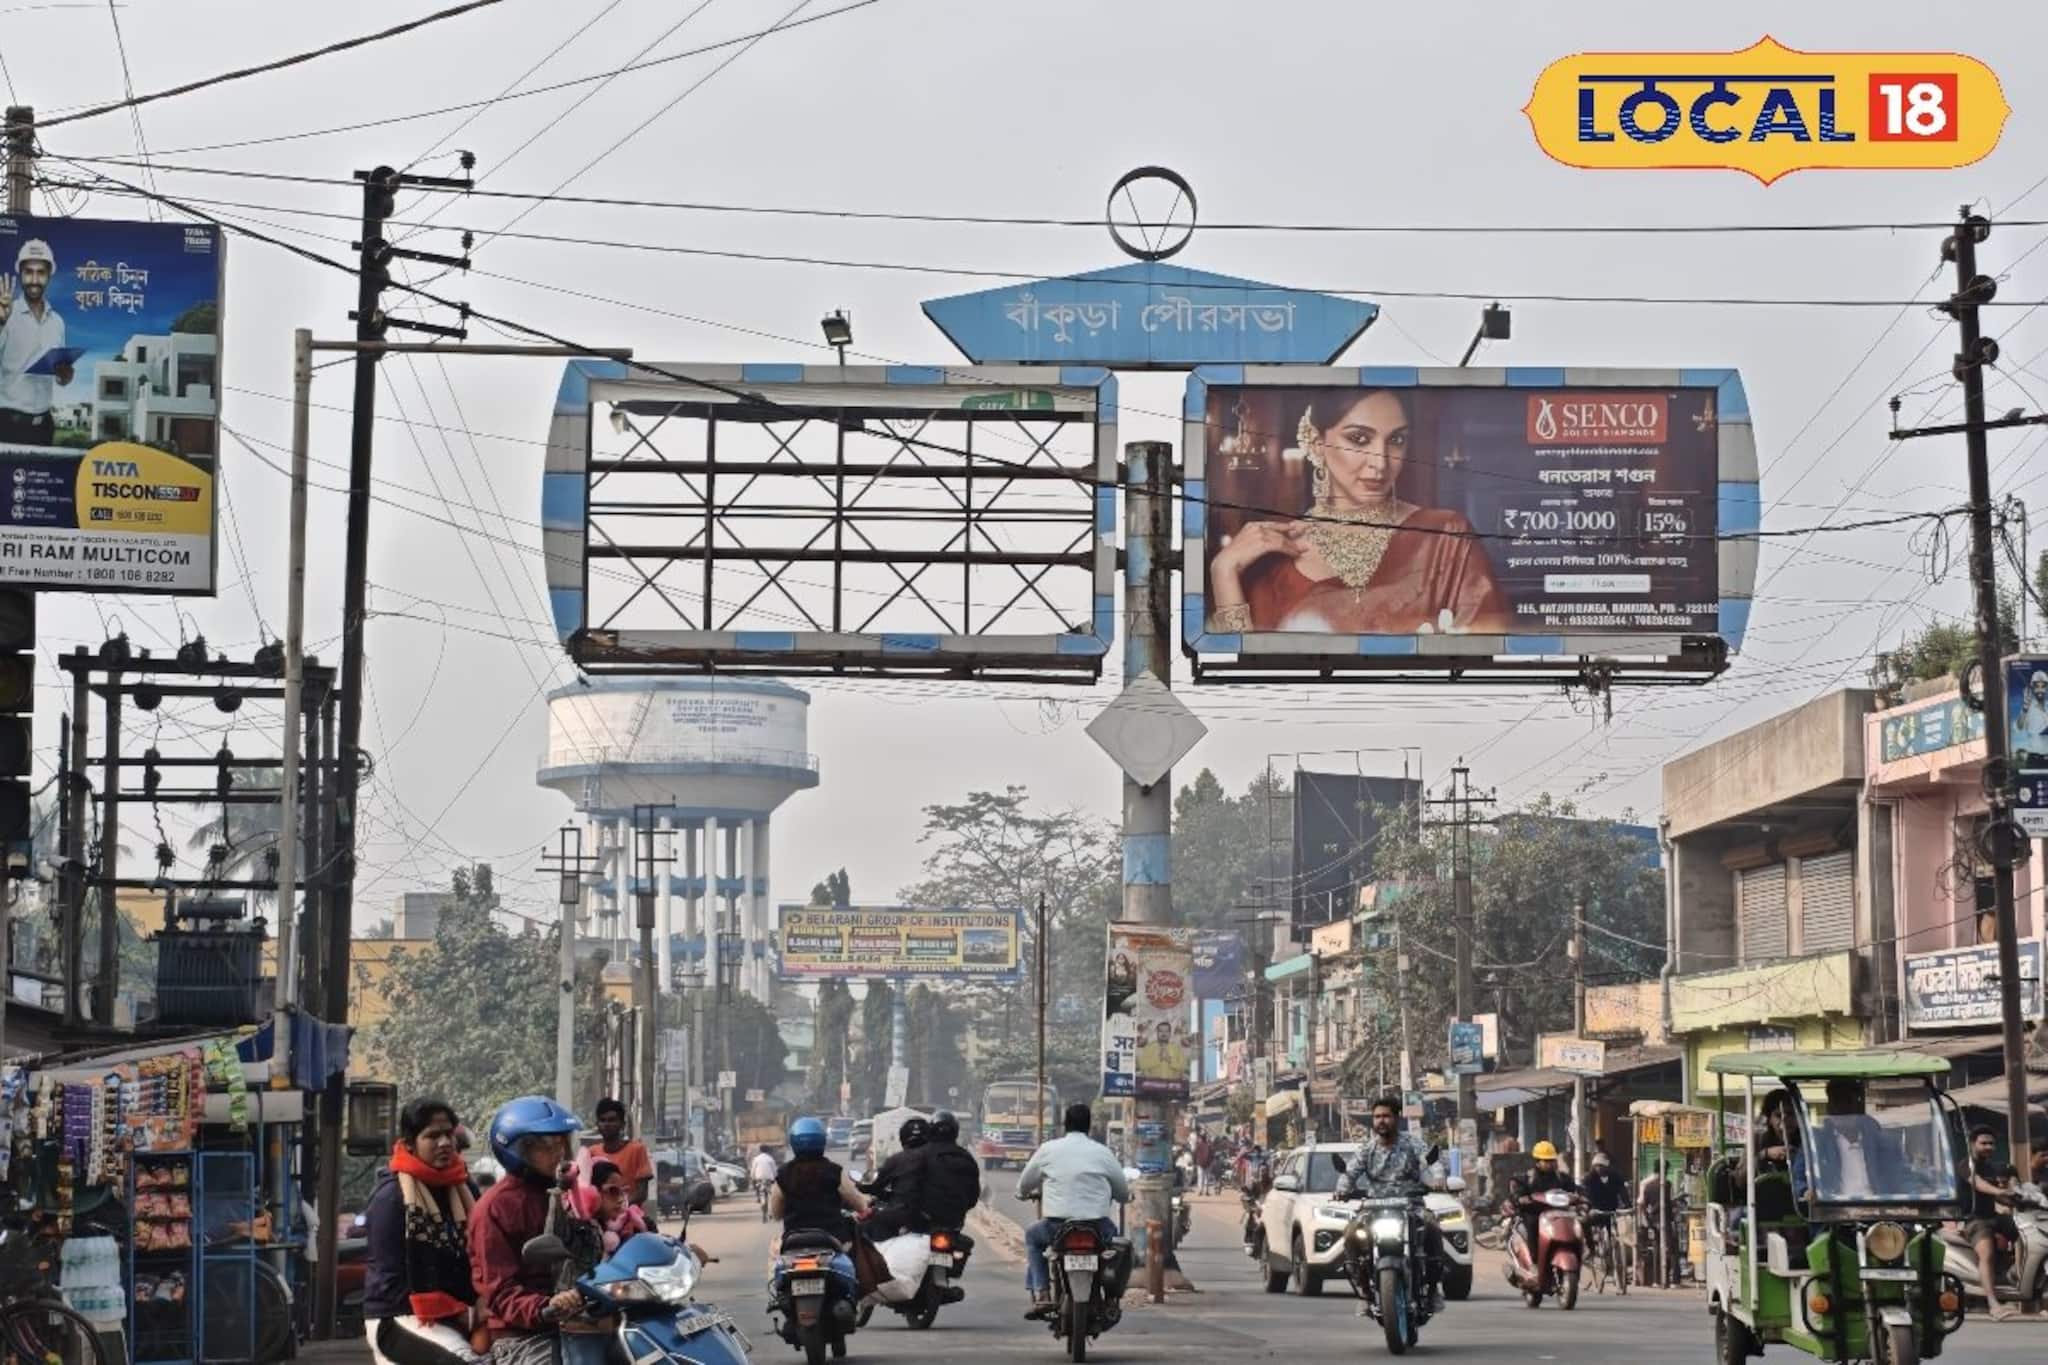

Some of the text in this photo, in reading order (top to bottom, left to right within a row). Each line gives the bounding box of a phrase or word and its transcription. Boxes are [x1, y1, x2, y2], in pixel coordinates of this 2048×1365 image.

[116, 262, 148, 289] চিনুন
[75, 287, 144, 314] বুঝে কিনুন
[1005, 293, 1297, 343] বাঁকুড়া পৌরসভা
[1562, 403, 1659, 428] SENCO
[92, 461, 139, 478] TATA
[1538, 468, 1657, 484] ধনতেরাস শগুন
[92, 483, 156, 501] TISCON
[1644, 513, 1687, 532] 15%
[0, 543, 191, 565] RI RAM MULTICOM
[867, 914, 909, 926] GROUP
[928, 915, 1010, 927] INSTITUTIONS
